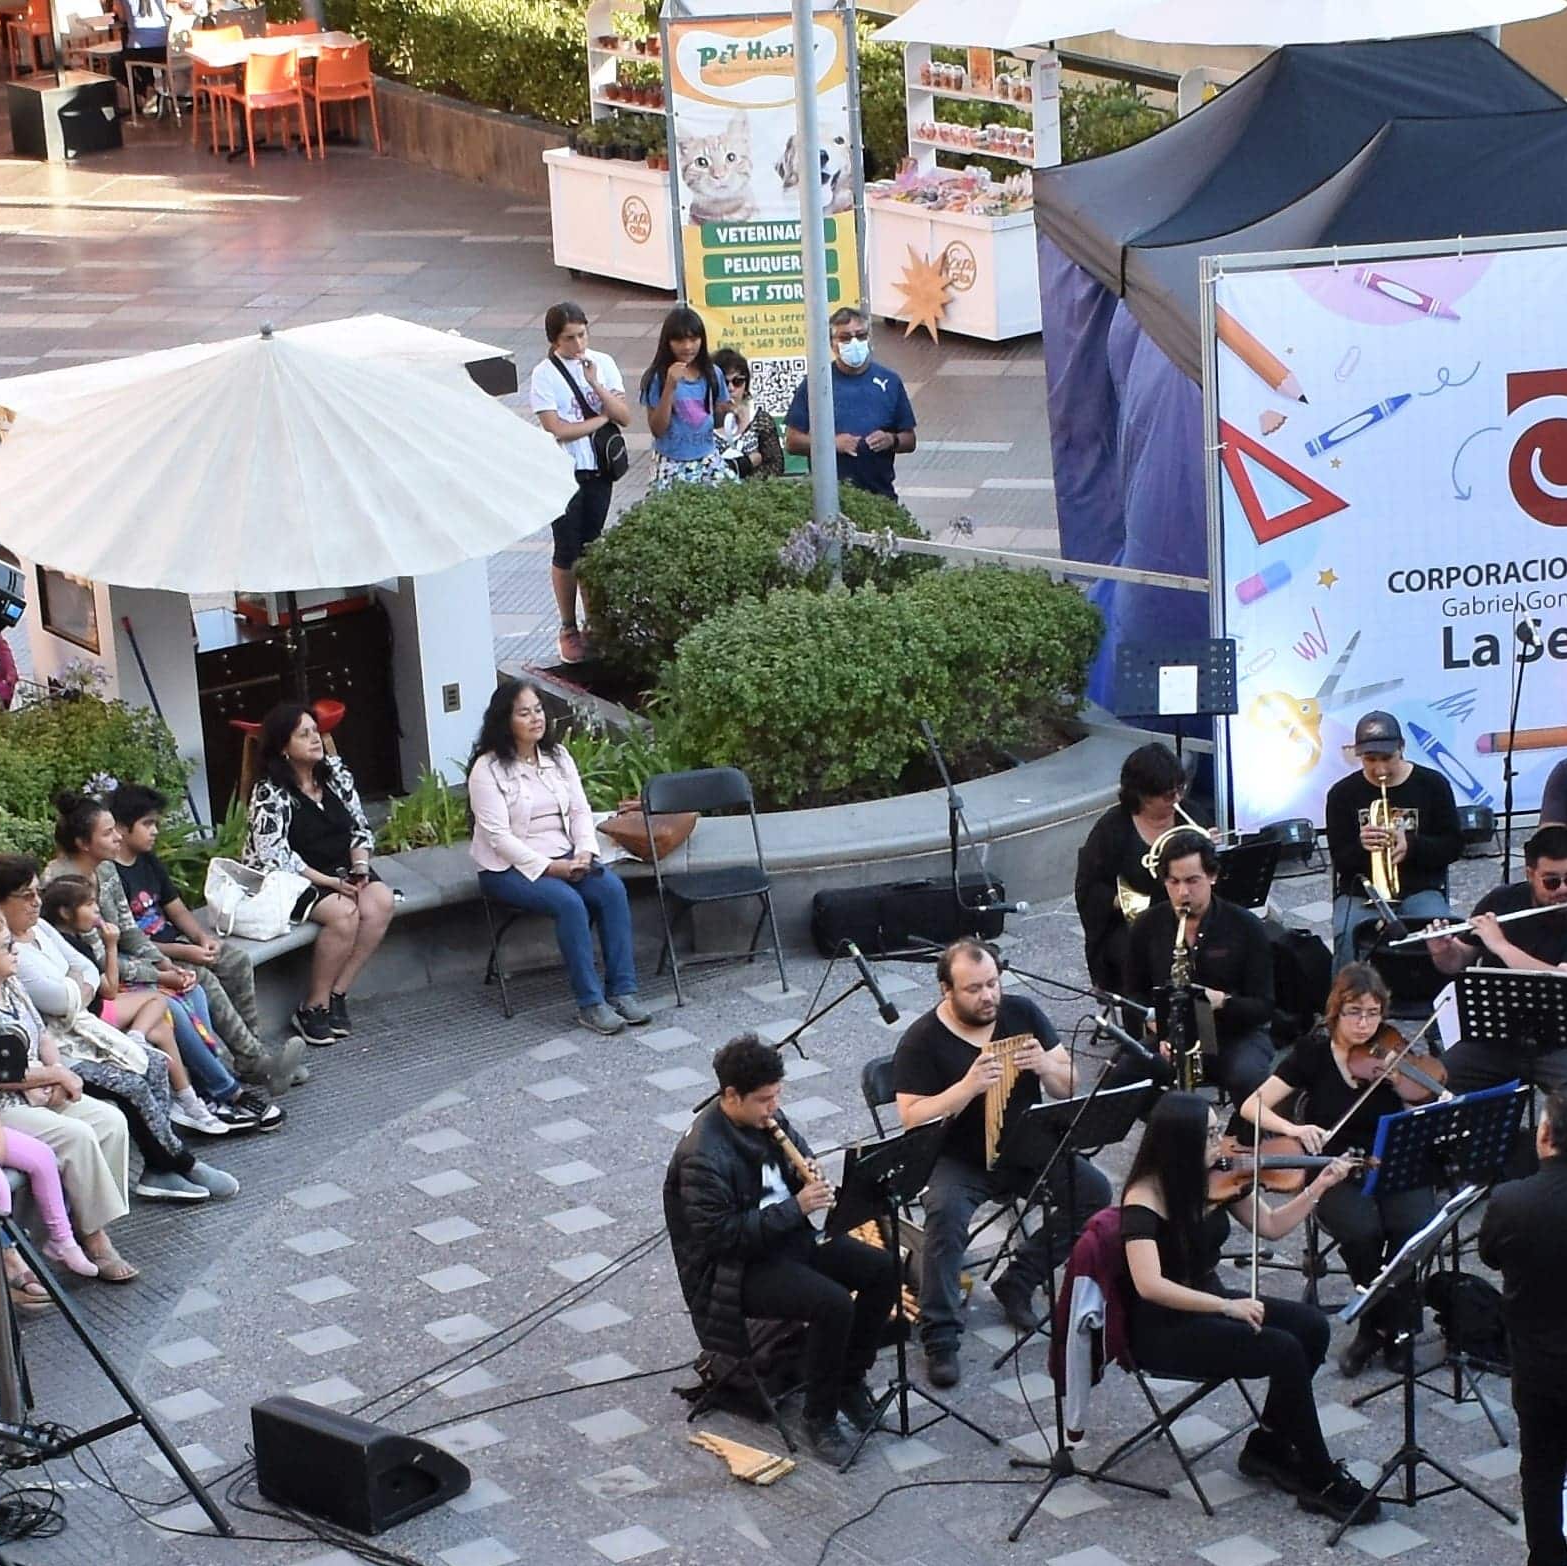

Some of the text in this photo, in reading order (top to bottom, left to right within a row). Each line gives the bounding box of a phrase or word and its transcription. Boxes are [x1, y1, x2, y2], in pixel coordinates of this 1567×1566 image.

[746, 40, 819, 62] HAP
[716, 224, 801, 244] VETERINAR
[724, 255, 802, 275] PELUQUER
[732, 284, 805, 303] PET STOR
[1442, 591, 1520, 617] Gabriel
[1443, 625, 1500, 670] La
